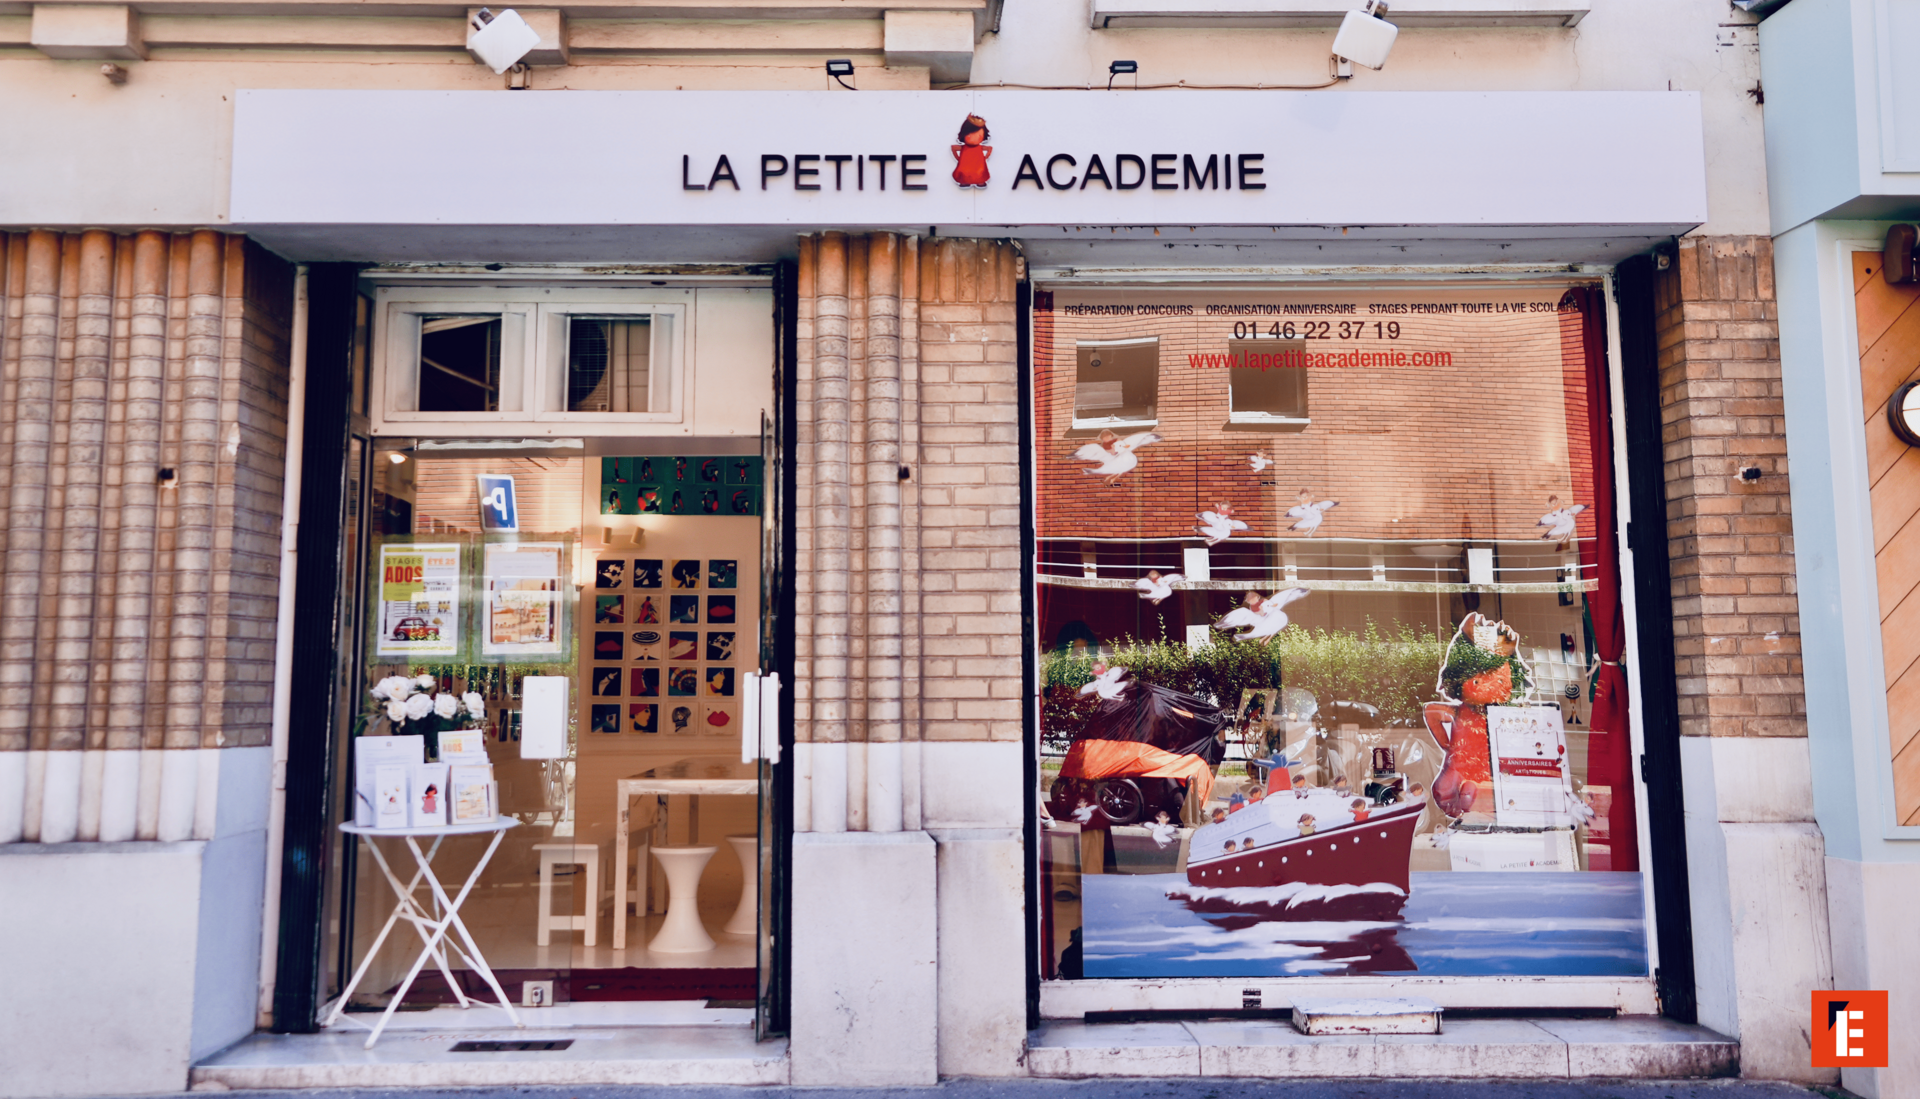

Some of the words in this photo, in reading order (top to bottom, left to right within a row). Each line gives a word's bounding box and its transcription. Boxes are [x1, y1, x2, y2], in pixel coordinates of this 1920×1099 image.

[682, 153, 741, 191] LA
[760, 153, 928, 191] PETITE
[1010, 152, 1267, 191] ACADEMIE
[1064, 303, 1134, 316] PRÉPARATION
[1137, 304, 1194, 316] CONCOURS
[1205, 304, 1280, 316] ORGANISATION
[1283, 303, 1357, 315] ANNIVERSAIRE
[1368, 303, 1408, 314] STAGES
[1410, 303, 1458, 314] PENDANT
[1460, 302, 1493, 314] TOUTE
[1495, 302, 1509, 313] LA
[1510, 302, 1527, 313] VIE
[1233, 321, 1256, 339] 01
[1268, 321, 1296, 339] 46
[1303, 321, 1331, 339] 22
[1338, 321, 1365, 339] 37
[1373, 321, 1401, 339] 19
[1188, 348, 1452, 371] www.lapetiteacademie.com
[385, 557, 424, 565] STAGES
[384, 565, 423, 583] ADOS
[1507, 759, 1553, 767] ANNIVERSAIRES
